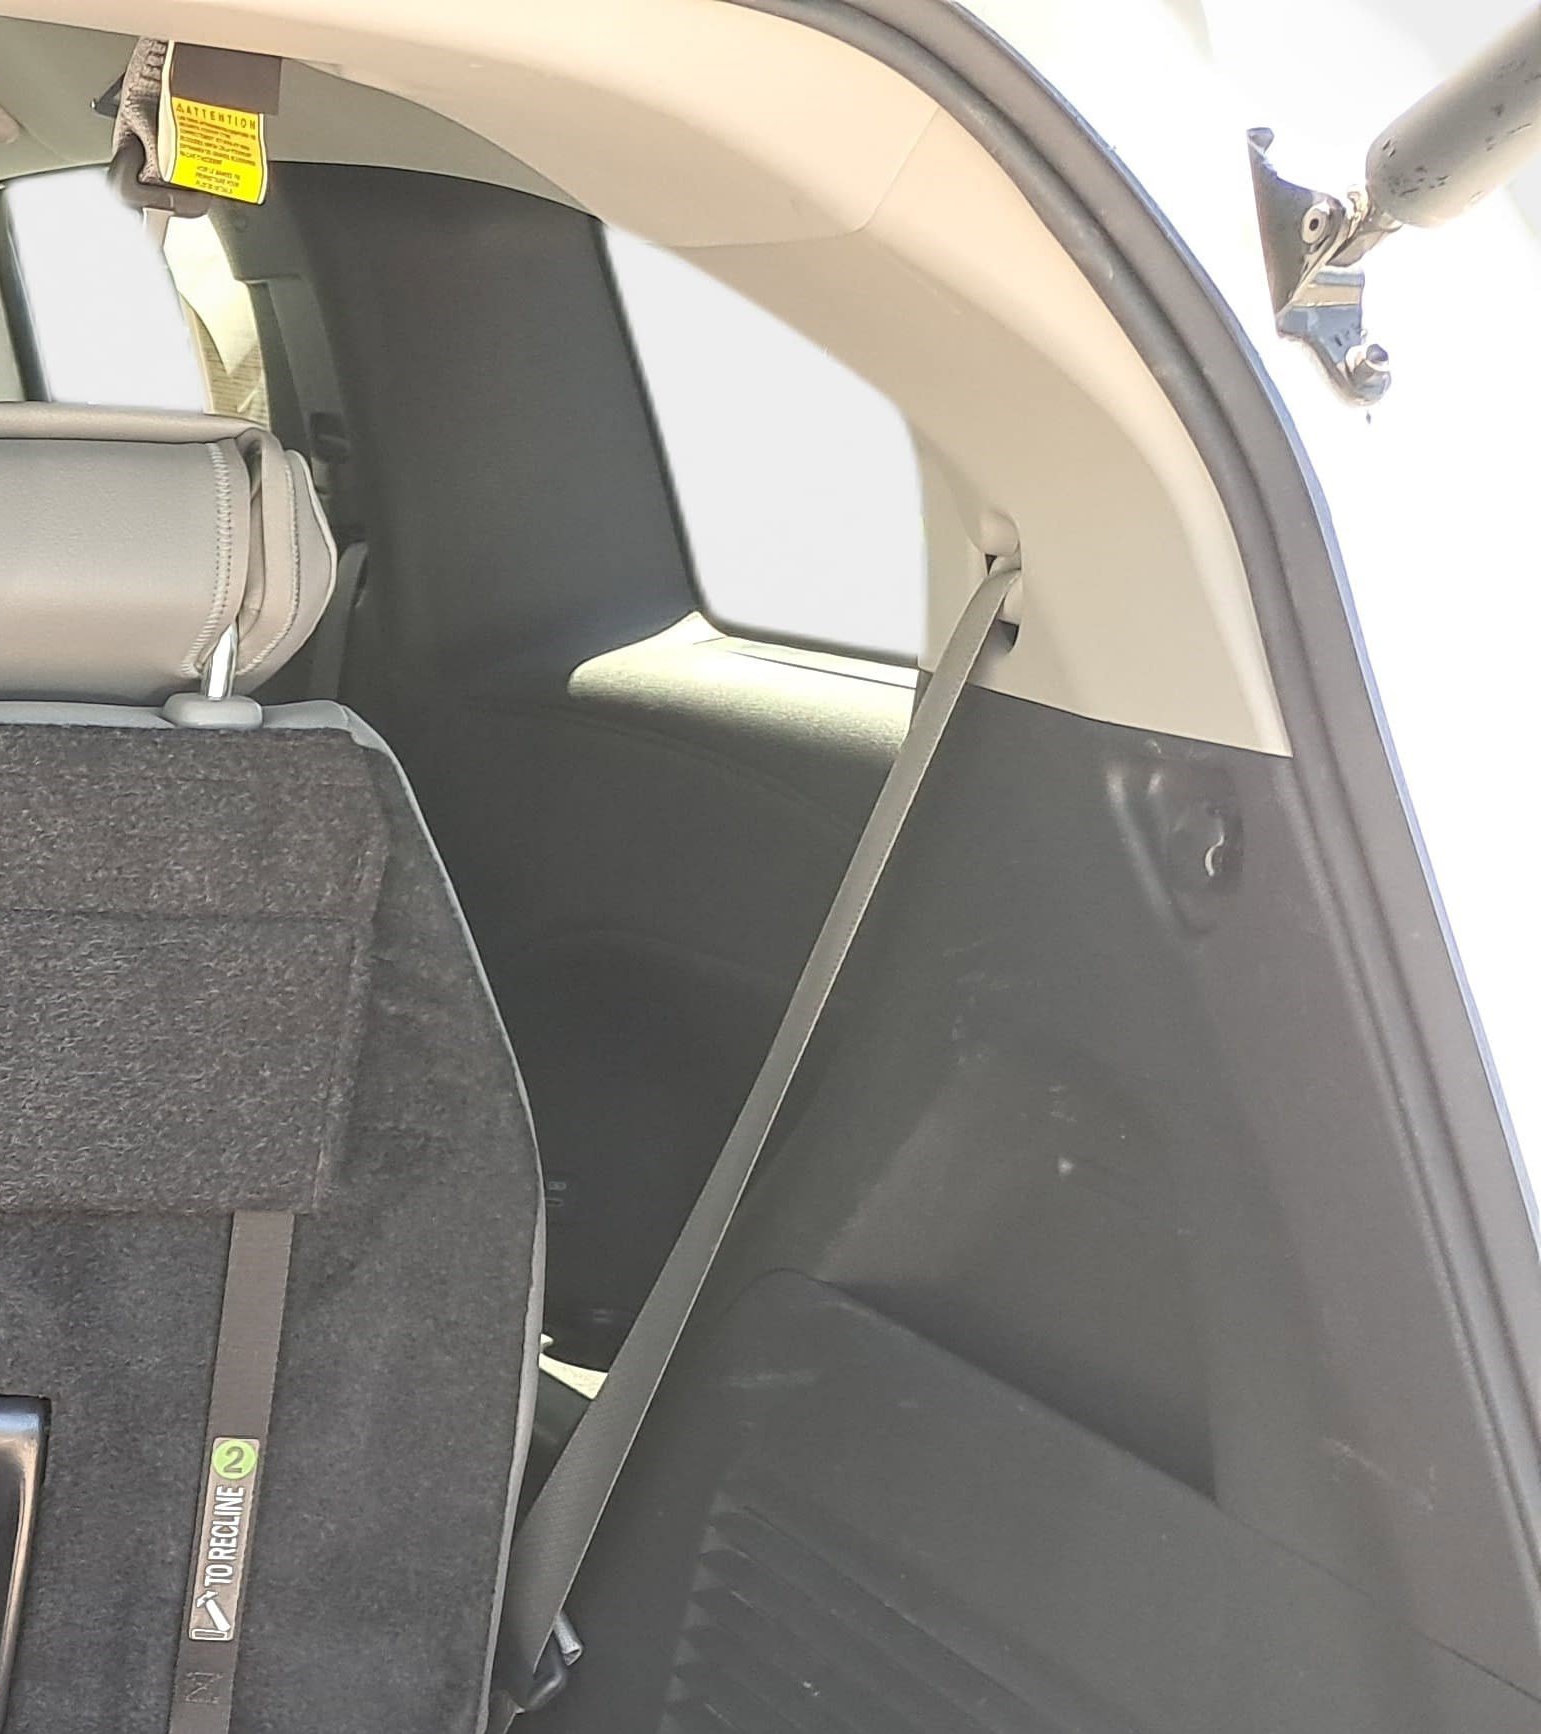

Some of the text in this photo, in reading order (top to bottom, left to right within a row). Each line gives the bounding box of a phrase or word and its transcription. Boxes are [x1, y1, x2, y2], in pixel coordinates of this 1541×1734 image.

[185, 107, 257, 130] ATTENTION
[223, 1446, 245, 1473] 2
[205, 1485, 246, 1587] TO RECLINE
